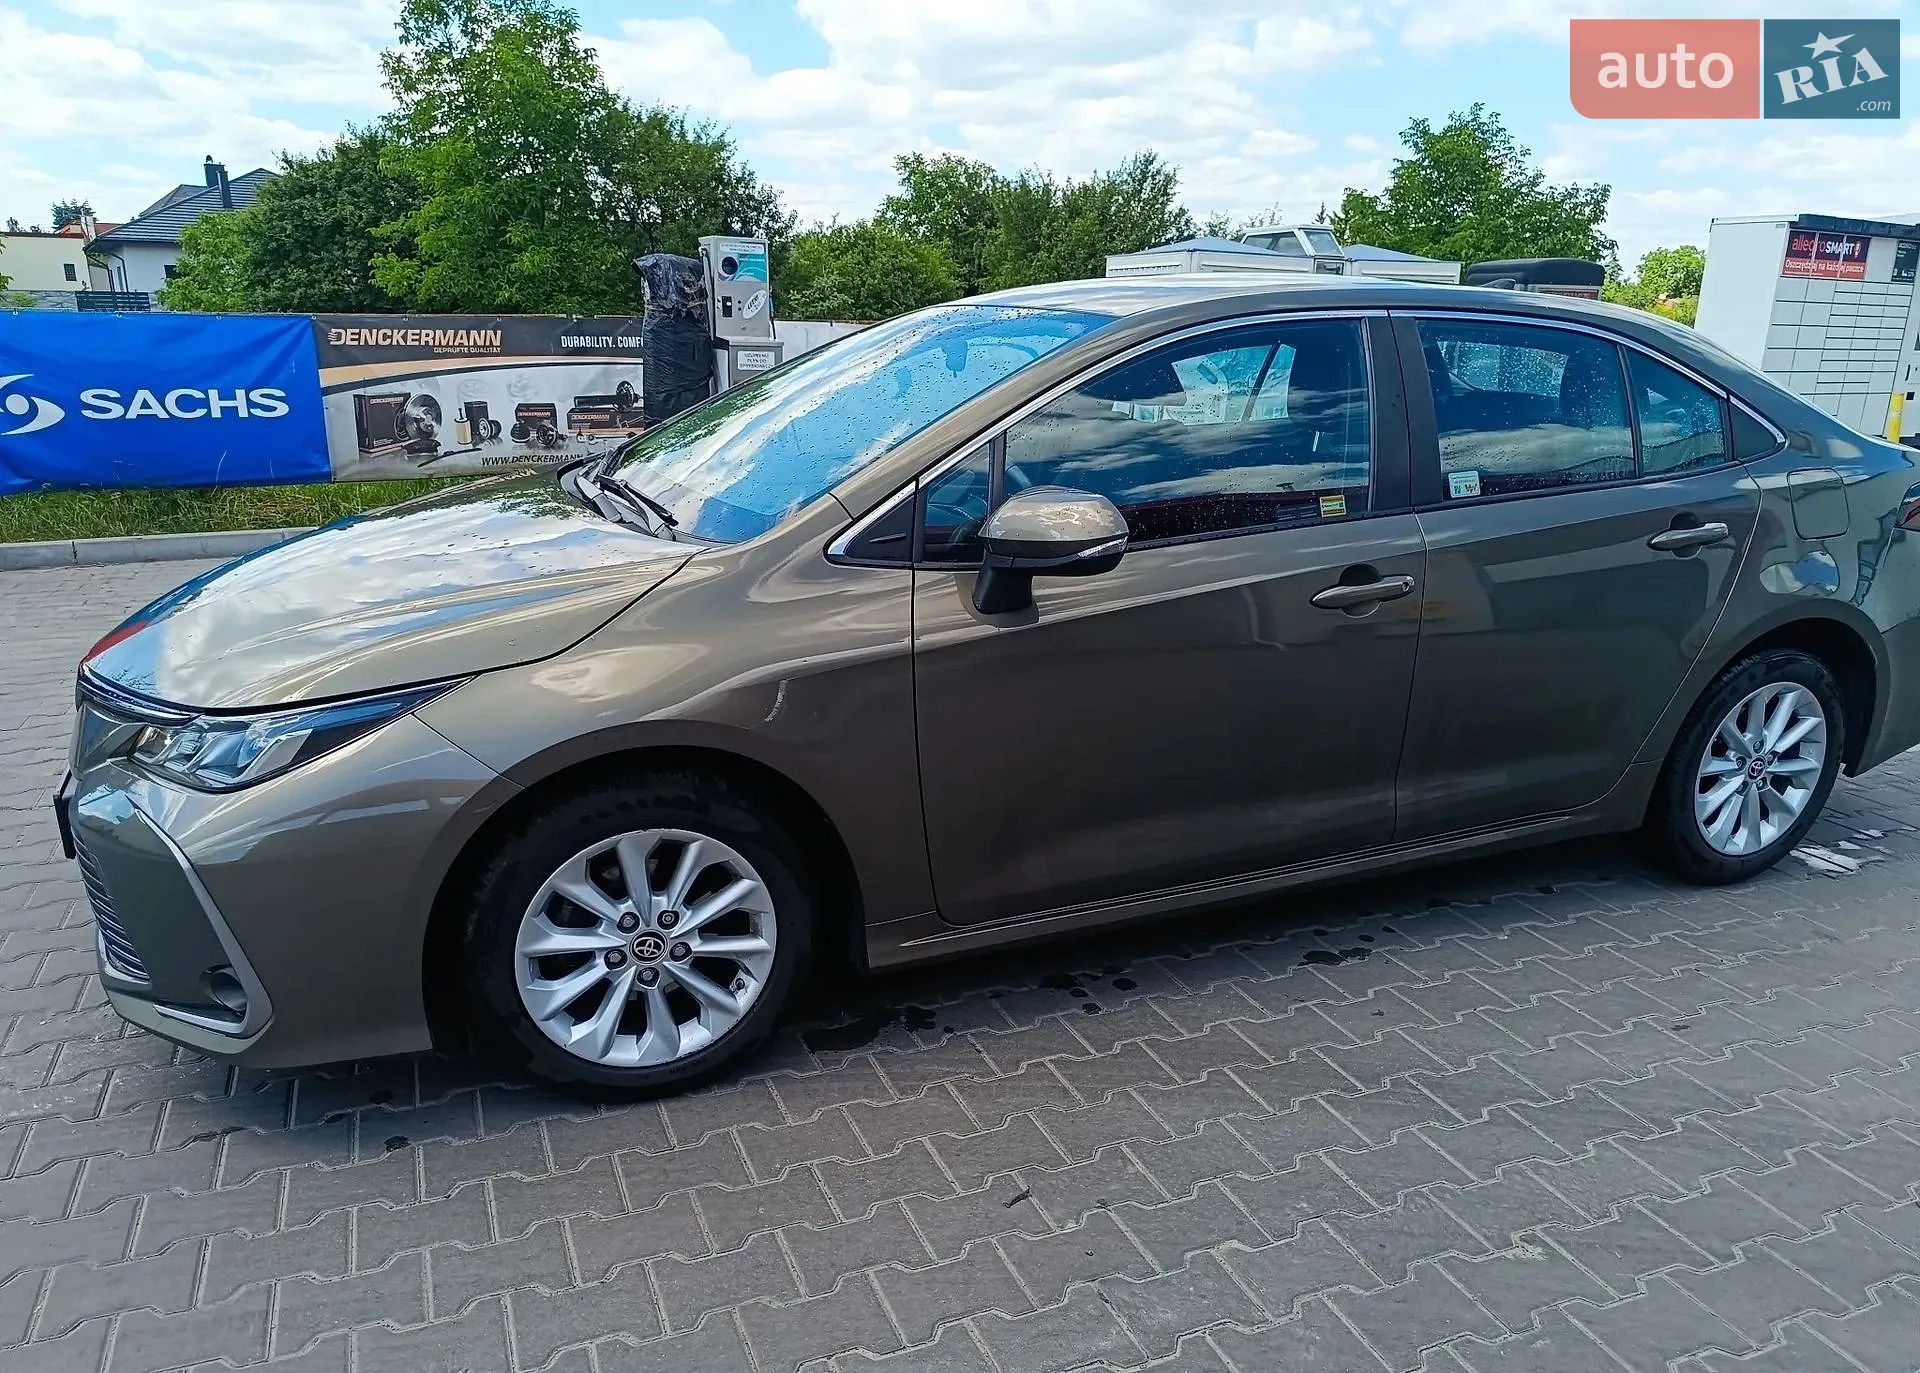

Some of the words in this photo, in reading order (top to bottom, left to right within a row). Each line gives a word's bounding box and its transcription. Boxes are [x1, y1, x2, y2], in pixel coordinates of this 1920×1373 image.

[327, 328, 502, 346] DENCKERMANN
[561, 335, 616, 348] DURABILITY.
[79, 388, 290, 420] SACHS
